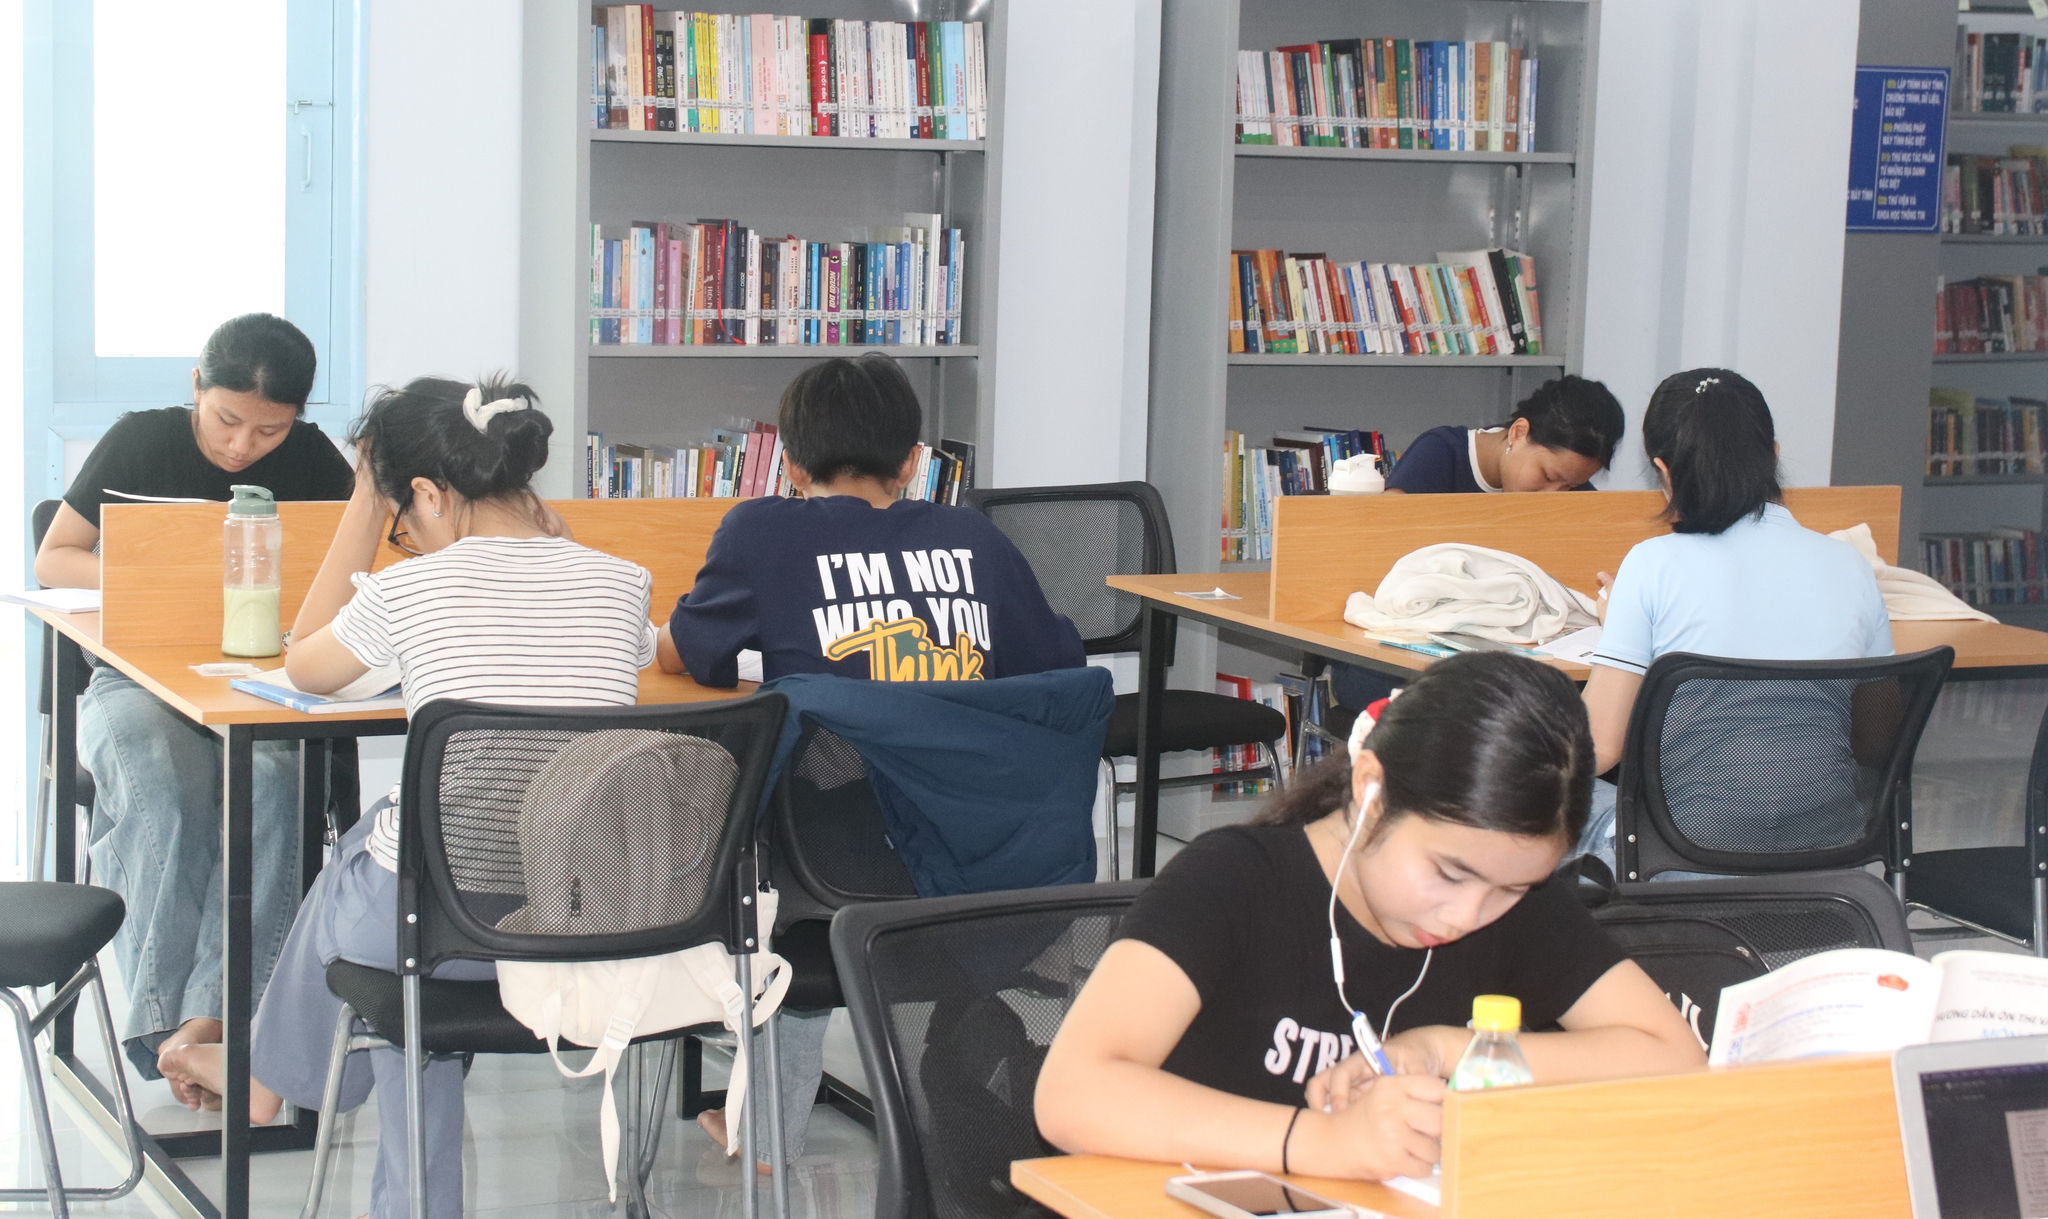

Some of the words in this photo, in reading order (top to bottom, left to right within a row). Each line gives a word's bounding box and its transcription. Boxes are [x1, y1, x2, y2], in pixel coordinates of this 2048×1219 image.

[816, 552, 895, 600] I’M
[901, 549, 975, 595] NOT
[826, 616, 985, 682] Think
[925, 597, 991, 651] YOU
